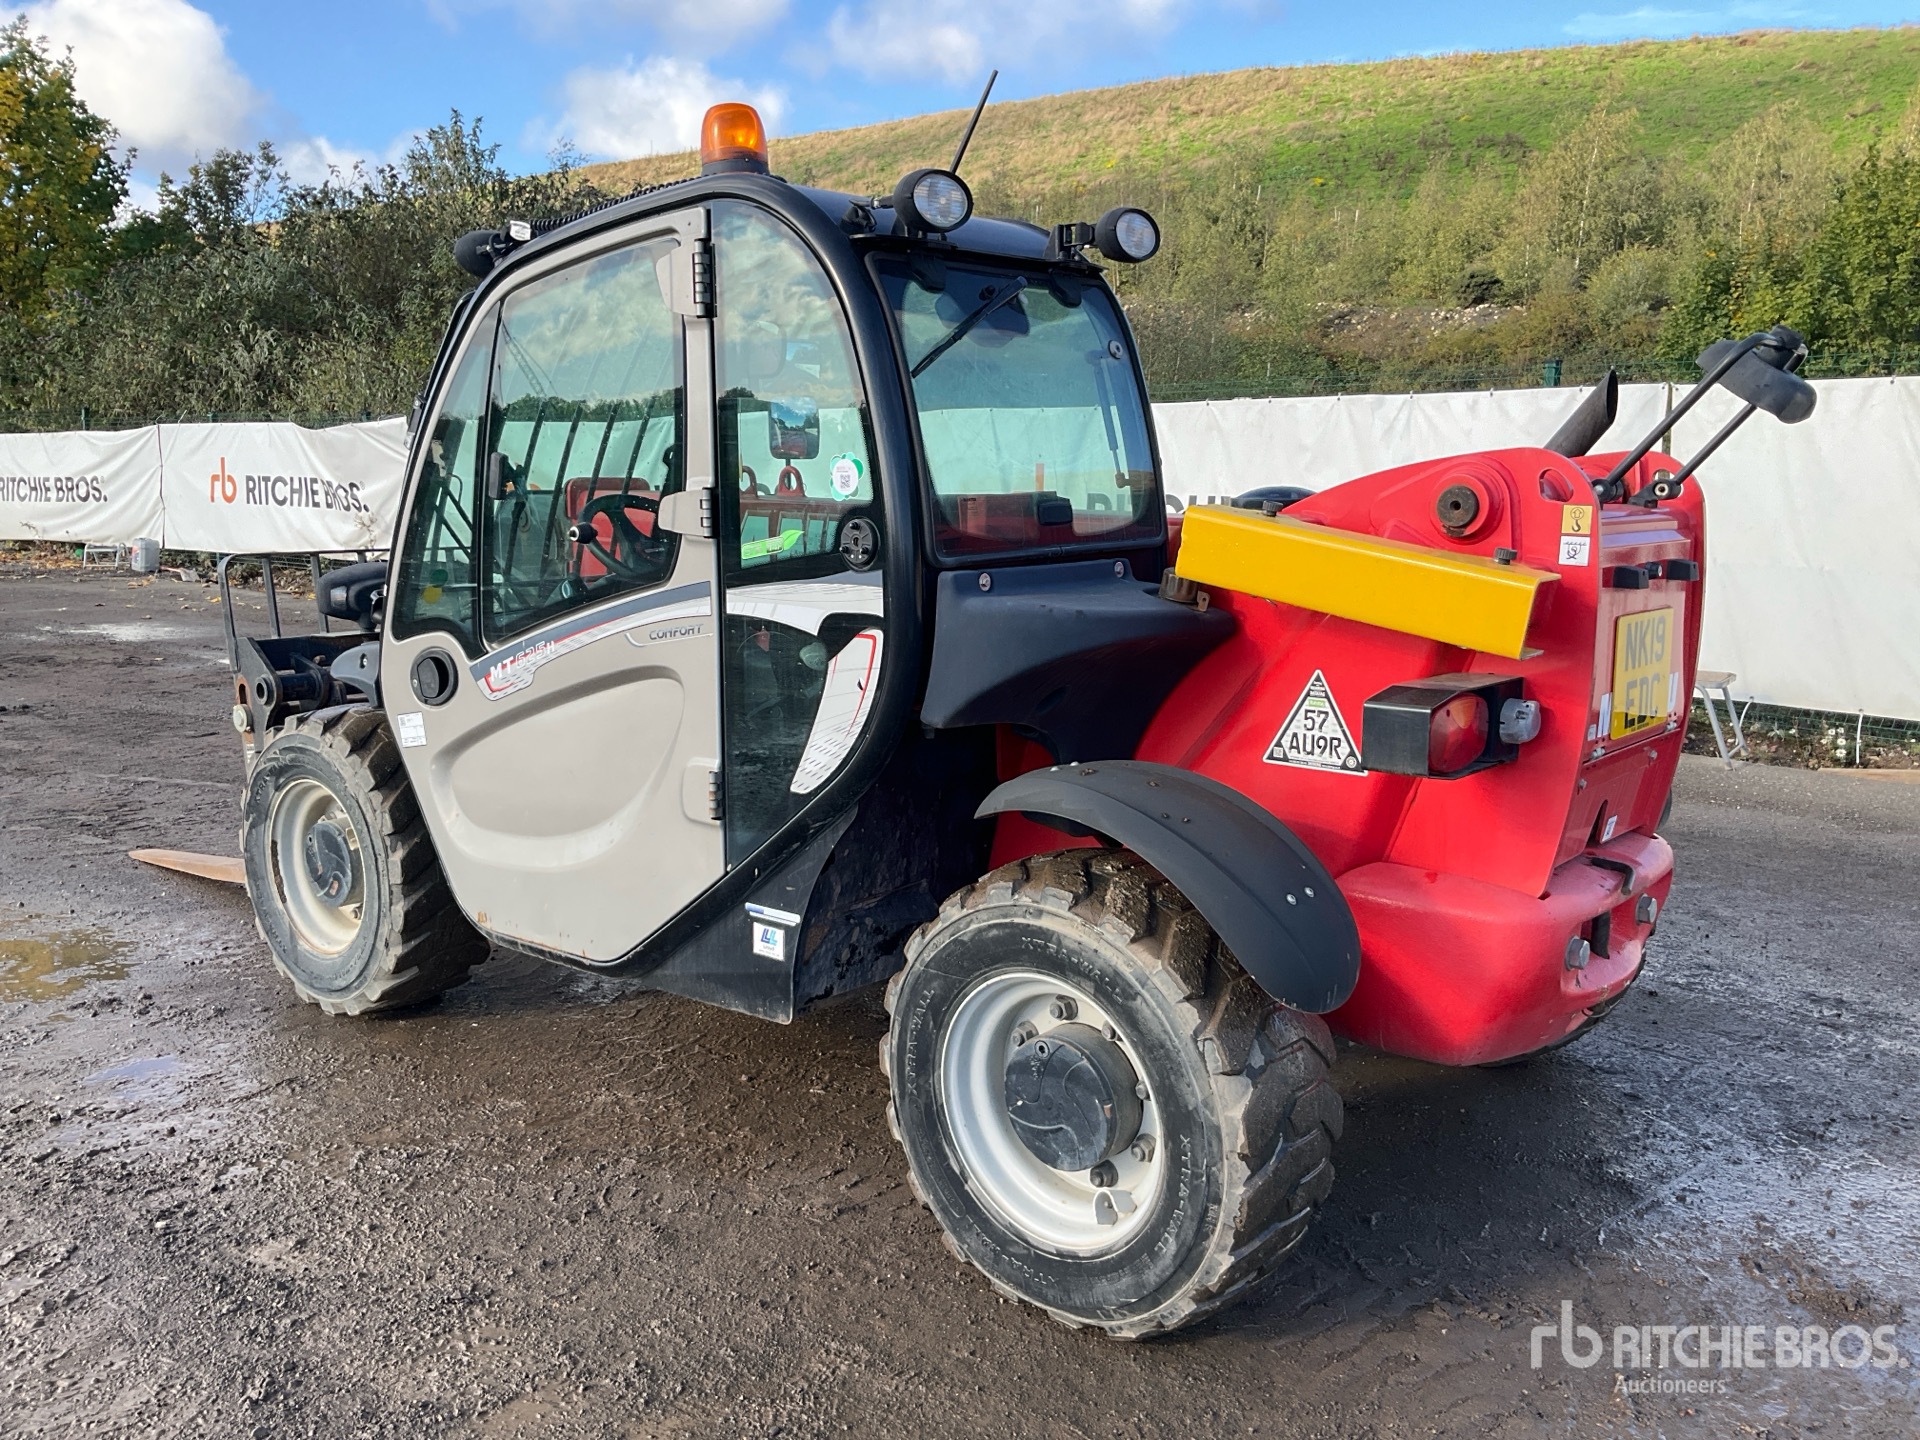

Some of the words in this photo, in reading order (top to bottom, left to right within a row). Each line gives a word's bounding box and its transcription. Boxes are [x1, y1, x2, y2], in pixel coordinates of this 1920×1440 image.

[54, 475, 108, 502] BROS.
[245, 475, 321, 508] RITCHIE
[320, 481, 370, 513] BROS.
[1625, 615, 1666, 671] NK19
[1624, 672, 1660, 729] EDC
[1303, 709, 1330, 732] 57
[1289, 732, 1342, 760] AU9R
